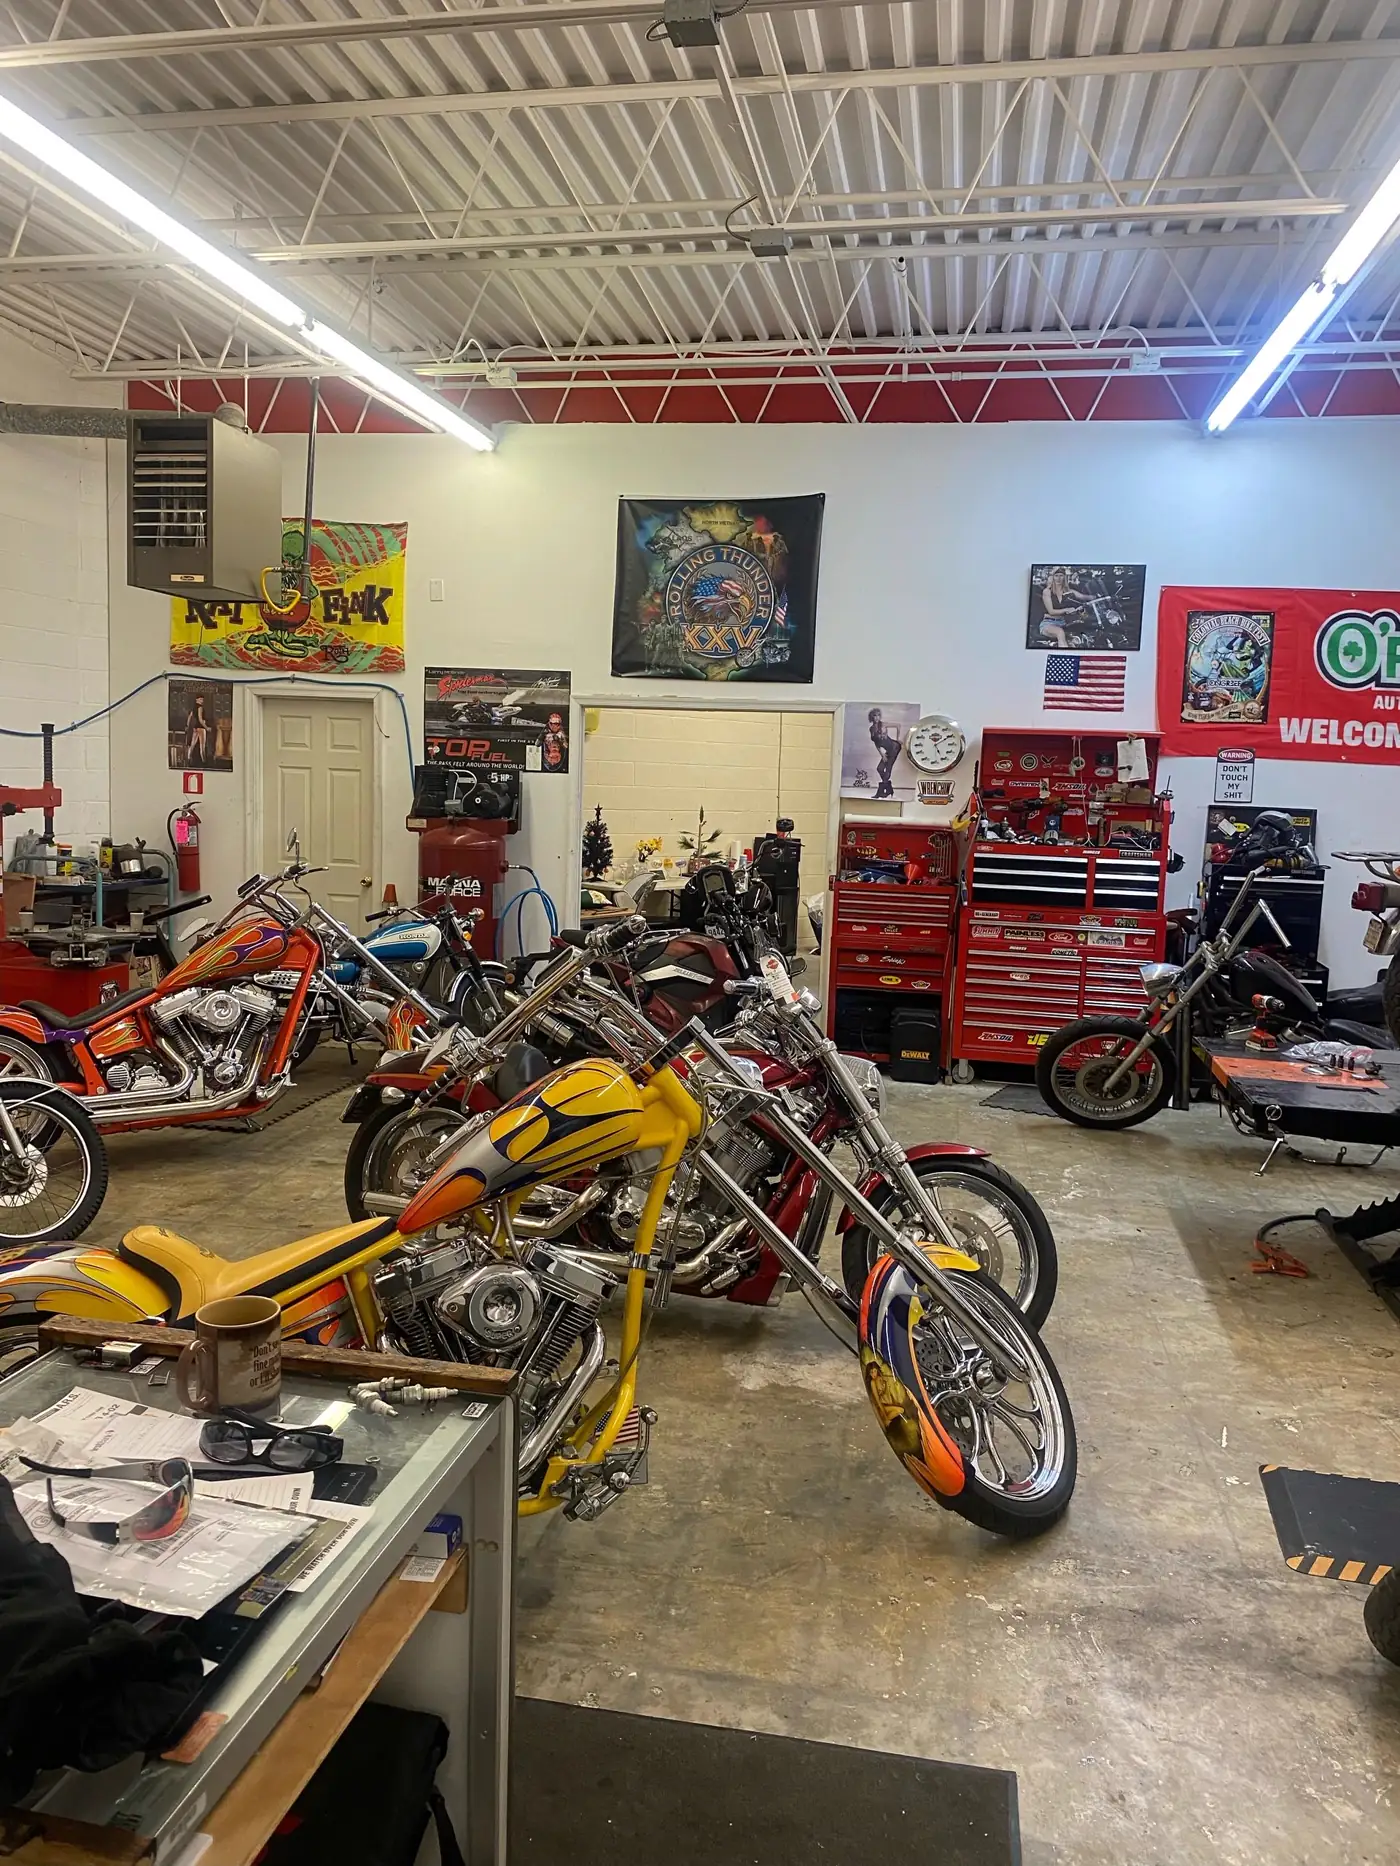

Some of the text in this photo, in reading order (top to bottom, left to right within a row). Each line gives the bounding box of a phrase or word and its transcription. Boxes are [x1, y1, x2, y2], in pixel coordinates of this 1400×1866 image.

[669, 548, 769, 619] ROLLING THUNDER
[320, 584, 394, 626] FINK
[1220, 615, 1241, 626] BEACH
[682, 623, 763, 653] XXV
[426, 738, 491, 757] TOP
[471, 752, 512, 762] FUEL
[1222, 765, 1248, 773] DON'T
[491, 772, 510, 783] 5 HP
[1223, 791, 1243, 799] SHIT
[427, 877, 481, 888] MANA
[1005, 928, 1046, 937] PAINLESS
[979, 1032, 1014, 1042] AMSOIL
[1027, 1034, 1049, 1045] JE
[254, 1360, 268, 1372] fine
